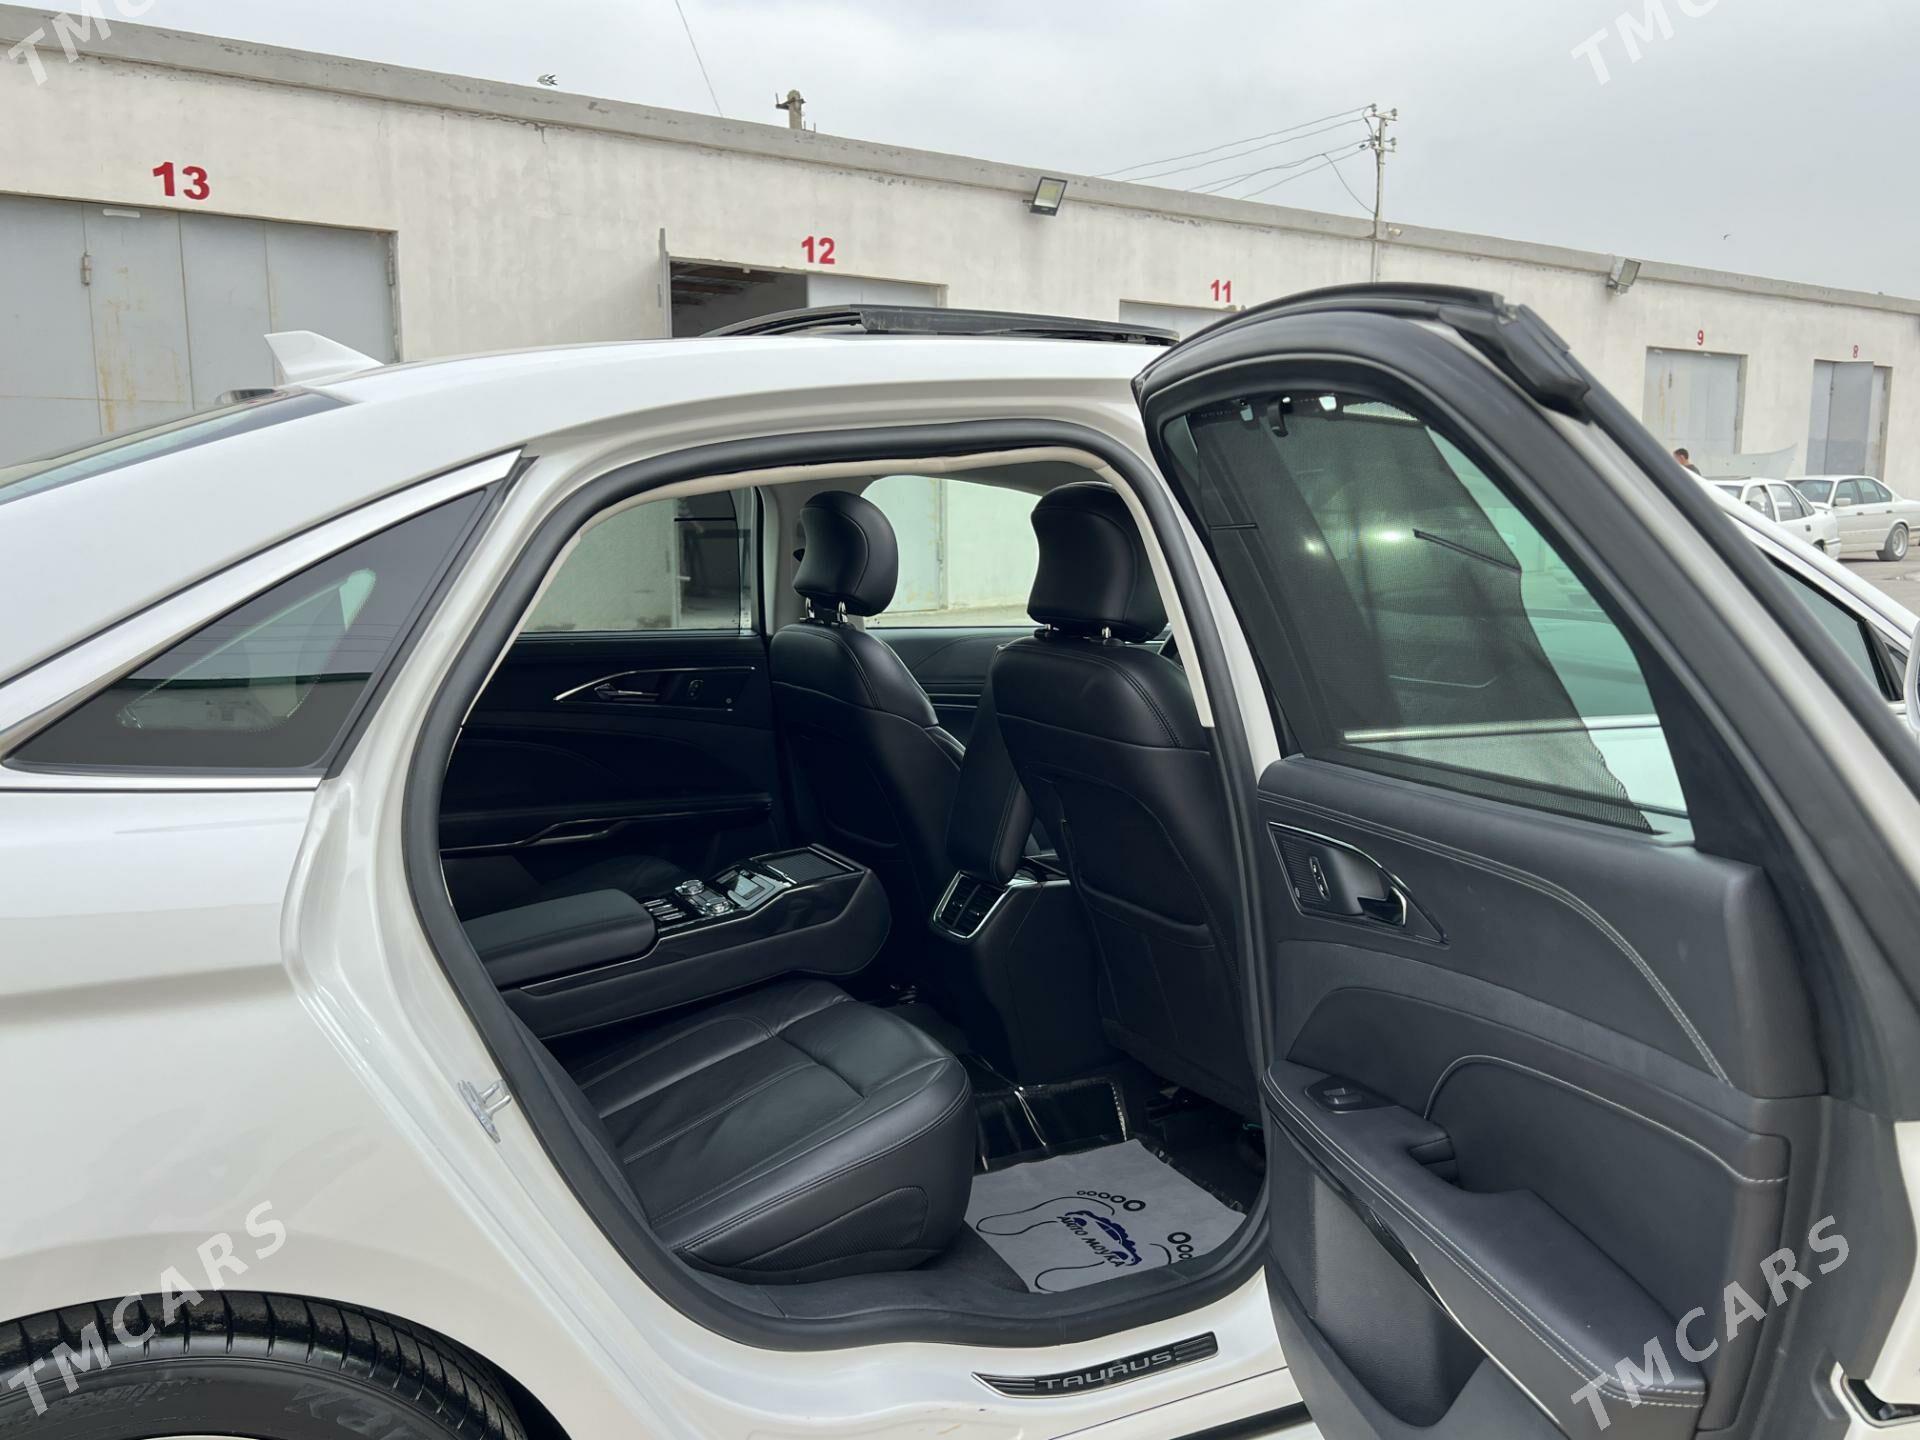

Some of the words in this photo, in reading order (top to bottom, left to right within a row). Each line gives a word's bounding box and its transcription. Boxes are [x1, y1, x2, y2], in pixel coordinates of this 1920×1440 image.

[152, 161, 211, 201] 13
[801, 236, 836, 265] 12
[1210, 279, 1232, 303] 11
[1696, 329, 1705, 346] 9
[1852, 344, 1860, 359] 8
[1038, 1350, 1172, 1390] TAURUS
